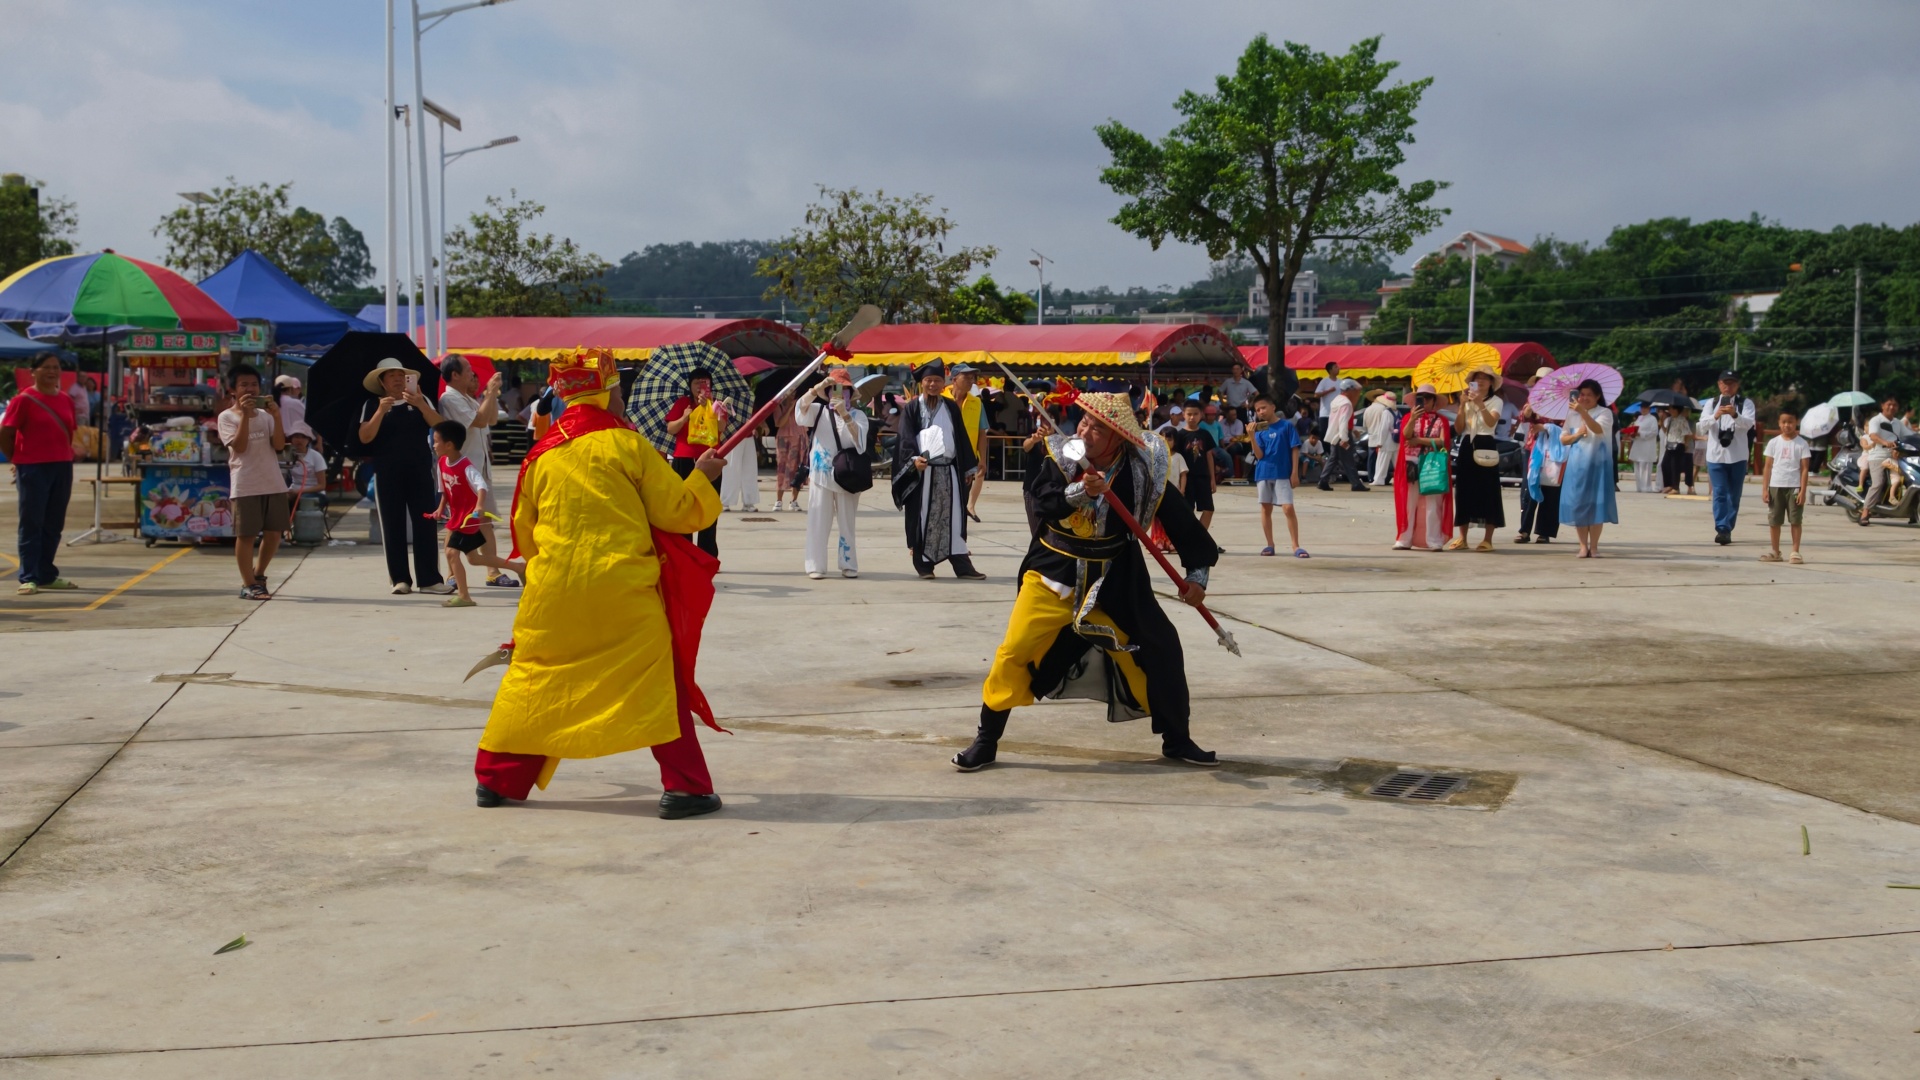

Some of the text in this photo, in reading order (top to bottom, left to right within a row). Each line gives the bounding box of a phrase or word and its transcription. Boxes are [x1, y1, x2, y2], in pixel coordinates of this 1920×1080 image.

[133, 335, 217, 348] 凉粉 豆花 糖水
